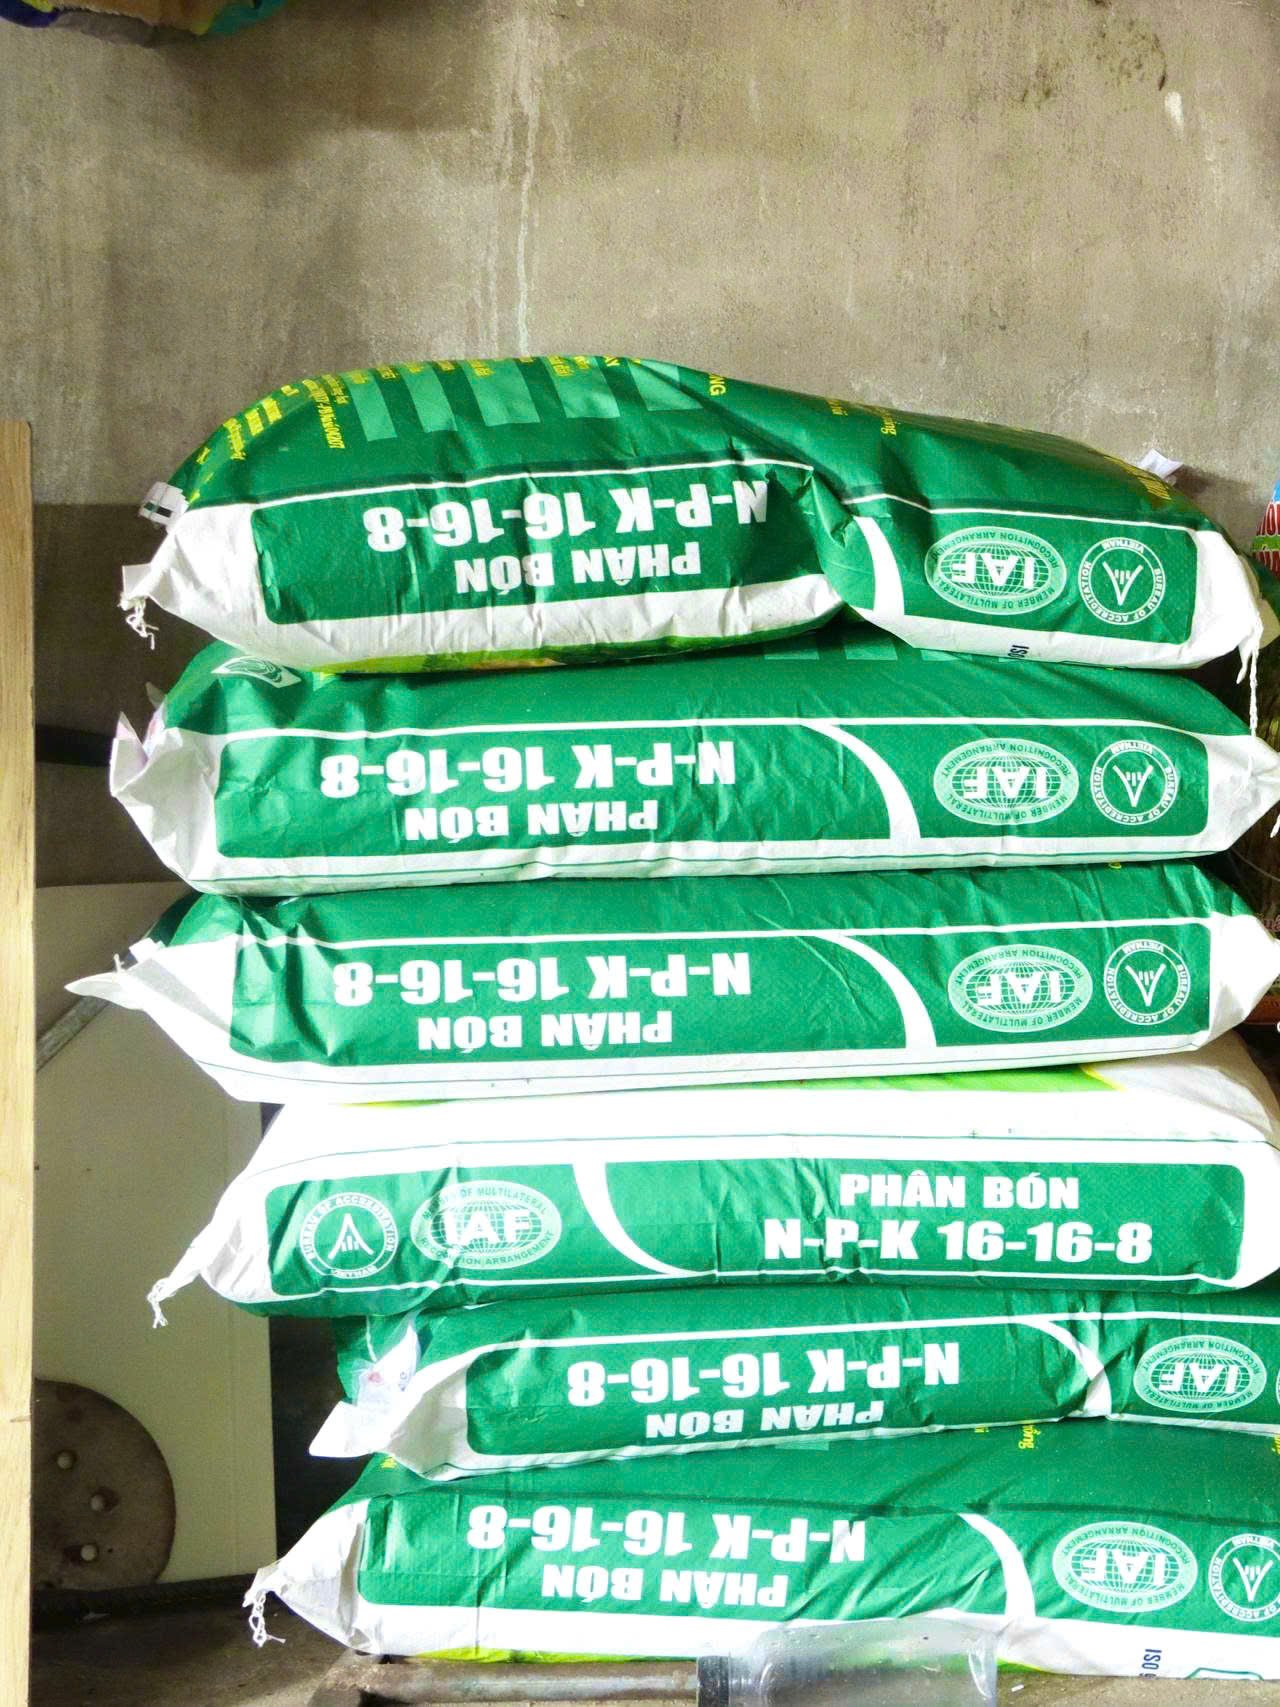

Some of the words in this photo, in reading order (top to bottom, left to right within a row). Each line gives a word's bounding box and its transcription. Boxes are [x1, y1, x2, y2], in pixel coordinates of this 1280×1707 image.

[363, 492, 596, 552] 16-16-8
[610, 481, 768, 533] N-P-K
[454, 552, 554, 595] BÓN
[572, 542, 700, 586] PHÂN
[952, 552, 1036, 589] IAF
[320, 746, 555, 798] 16-16-8
[571, 741, 735, 789] N-P-K
[962, 766, 1048, 799] IAF
[404, 805, 508, 843] BÓN
[528, 800, 658, 837] PHÂN
[333, 957, 569, 1007] 16-16-8
[586, 952, 751, 999] N-P-K
[977, 972, 1062, 1005] IAF
[418, 1015, 522, 1054] BÓN
[541, 1010, 672, 1051] PHÂN
[840, 1169, 966, 1207] PHÂN
[983, 1172, 1079, 1209] BÓN
[444, 1209, 529, 1245] IAF
[764, 1217, 920, 1260] N-P-K
[938, 1219, 1152, 1264] 16-16-8
[567, 1352, 790, 1406] 16-16-8
[806, 1342, 960, 1393] N-P-K
[1159, 1362, 1240, 1393] IAF
[645, 1409, 744, 1439] BÓN
[760, 1400, 884, 1431] PHÂN
[467, 1504, 692, 1557] 16-16-8
[709, 1513, 866, 1564] N-P-K
[541, 1563, 643, 1603] BÓN
[1081, 1549, 1166, 1586] IAF
[659, 1568, 789, 1609] PHÂN
[1141, 1648, 1163, 1670] ISO
